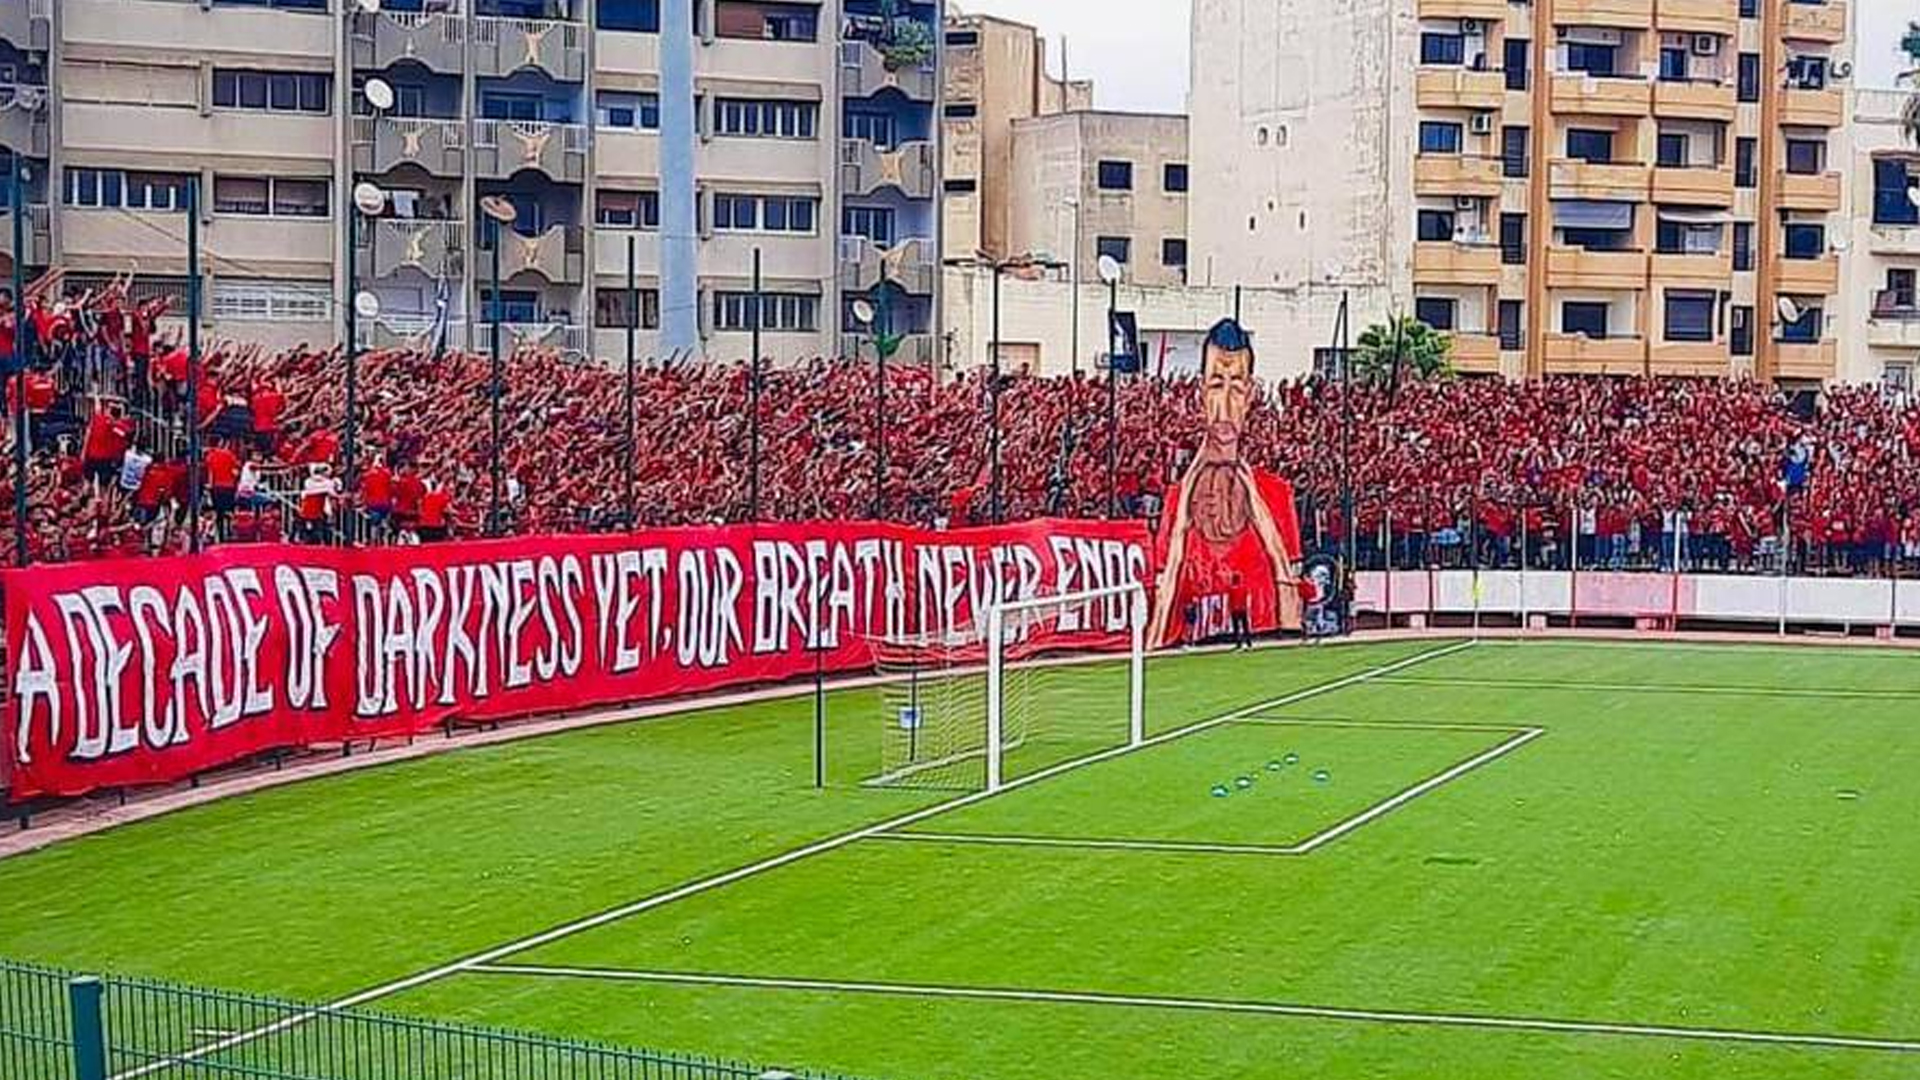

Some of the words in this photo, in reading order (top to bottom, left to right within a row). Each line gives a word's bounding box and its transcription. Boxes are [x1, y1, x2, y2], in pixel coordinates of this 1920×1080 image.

[15, 609, 60, 763] A
[51, 567, 273, 758] DECADE
[275, 564, 340, 708] OF
[352, 554, 584, 716] DARKNESS
[677, 546, 744, 667] OUR
[752, 538, 906, 653] BREATH
[915, 543, 1043, 646] NEVER
[1049, 535, 1147, 631] ENDS
